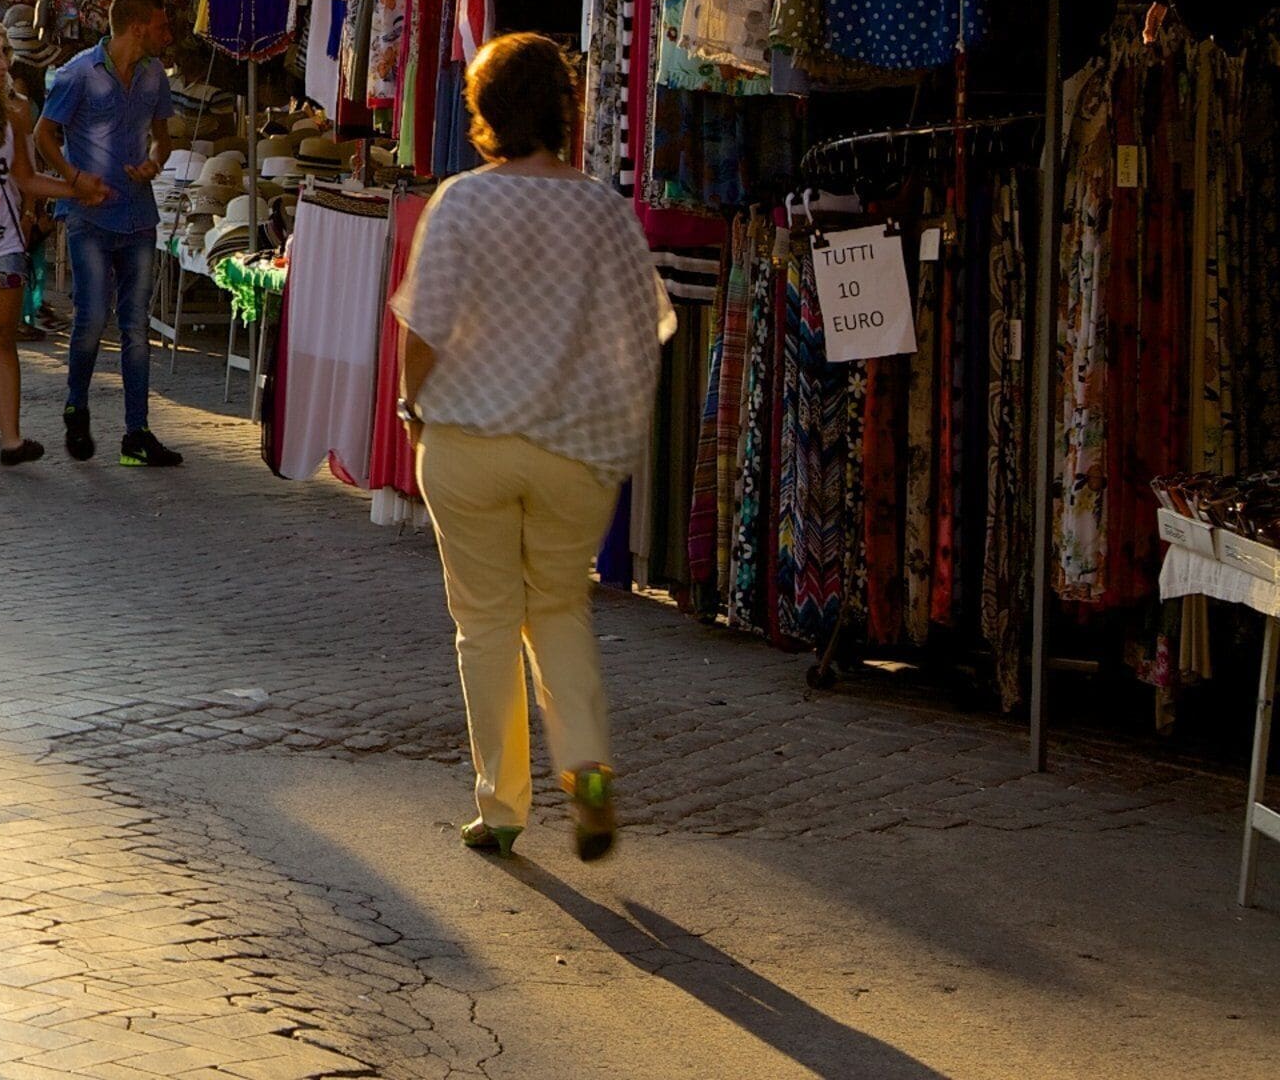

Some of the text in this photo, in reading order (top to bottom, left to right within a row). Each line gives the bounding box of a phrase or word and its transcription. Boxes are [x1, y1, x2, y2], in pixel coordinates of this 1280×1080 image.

[822, 244, 874, 266] TUTTI
[837, 281, 860, 299] 10
[832, 310, 884, 332] EURO
